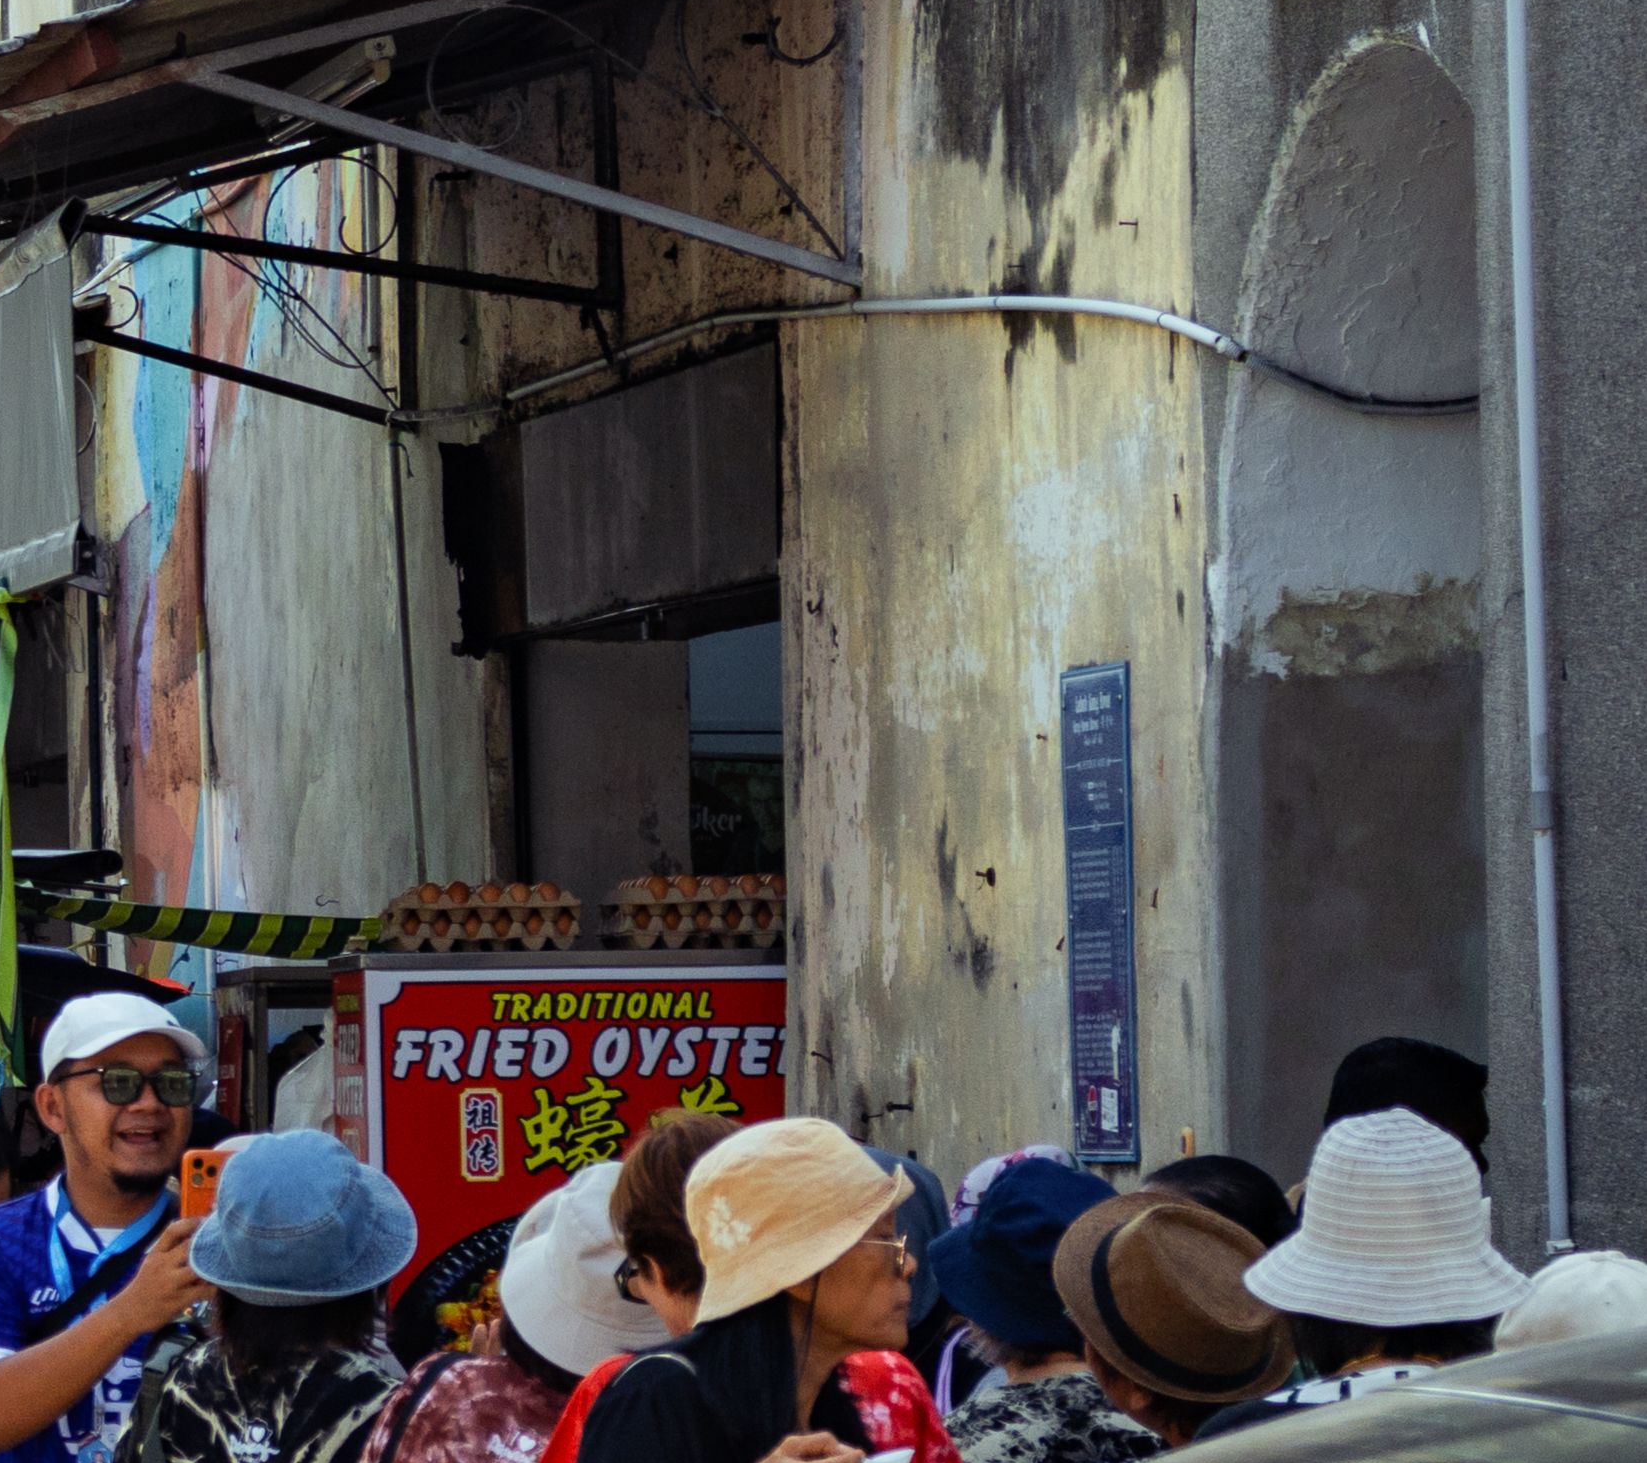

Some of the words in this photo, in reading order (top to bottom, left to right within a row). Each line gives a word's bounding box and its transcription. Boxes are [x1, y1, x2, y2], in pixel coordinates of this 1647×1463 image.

[491, 990, 714, 1022] TRADITIONAL
[391, 1027, 570, 1083] FRIED
[464, 1101, 500, 1173] 祖传
